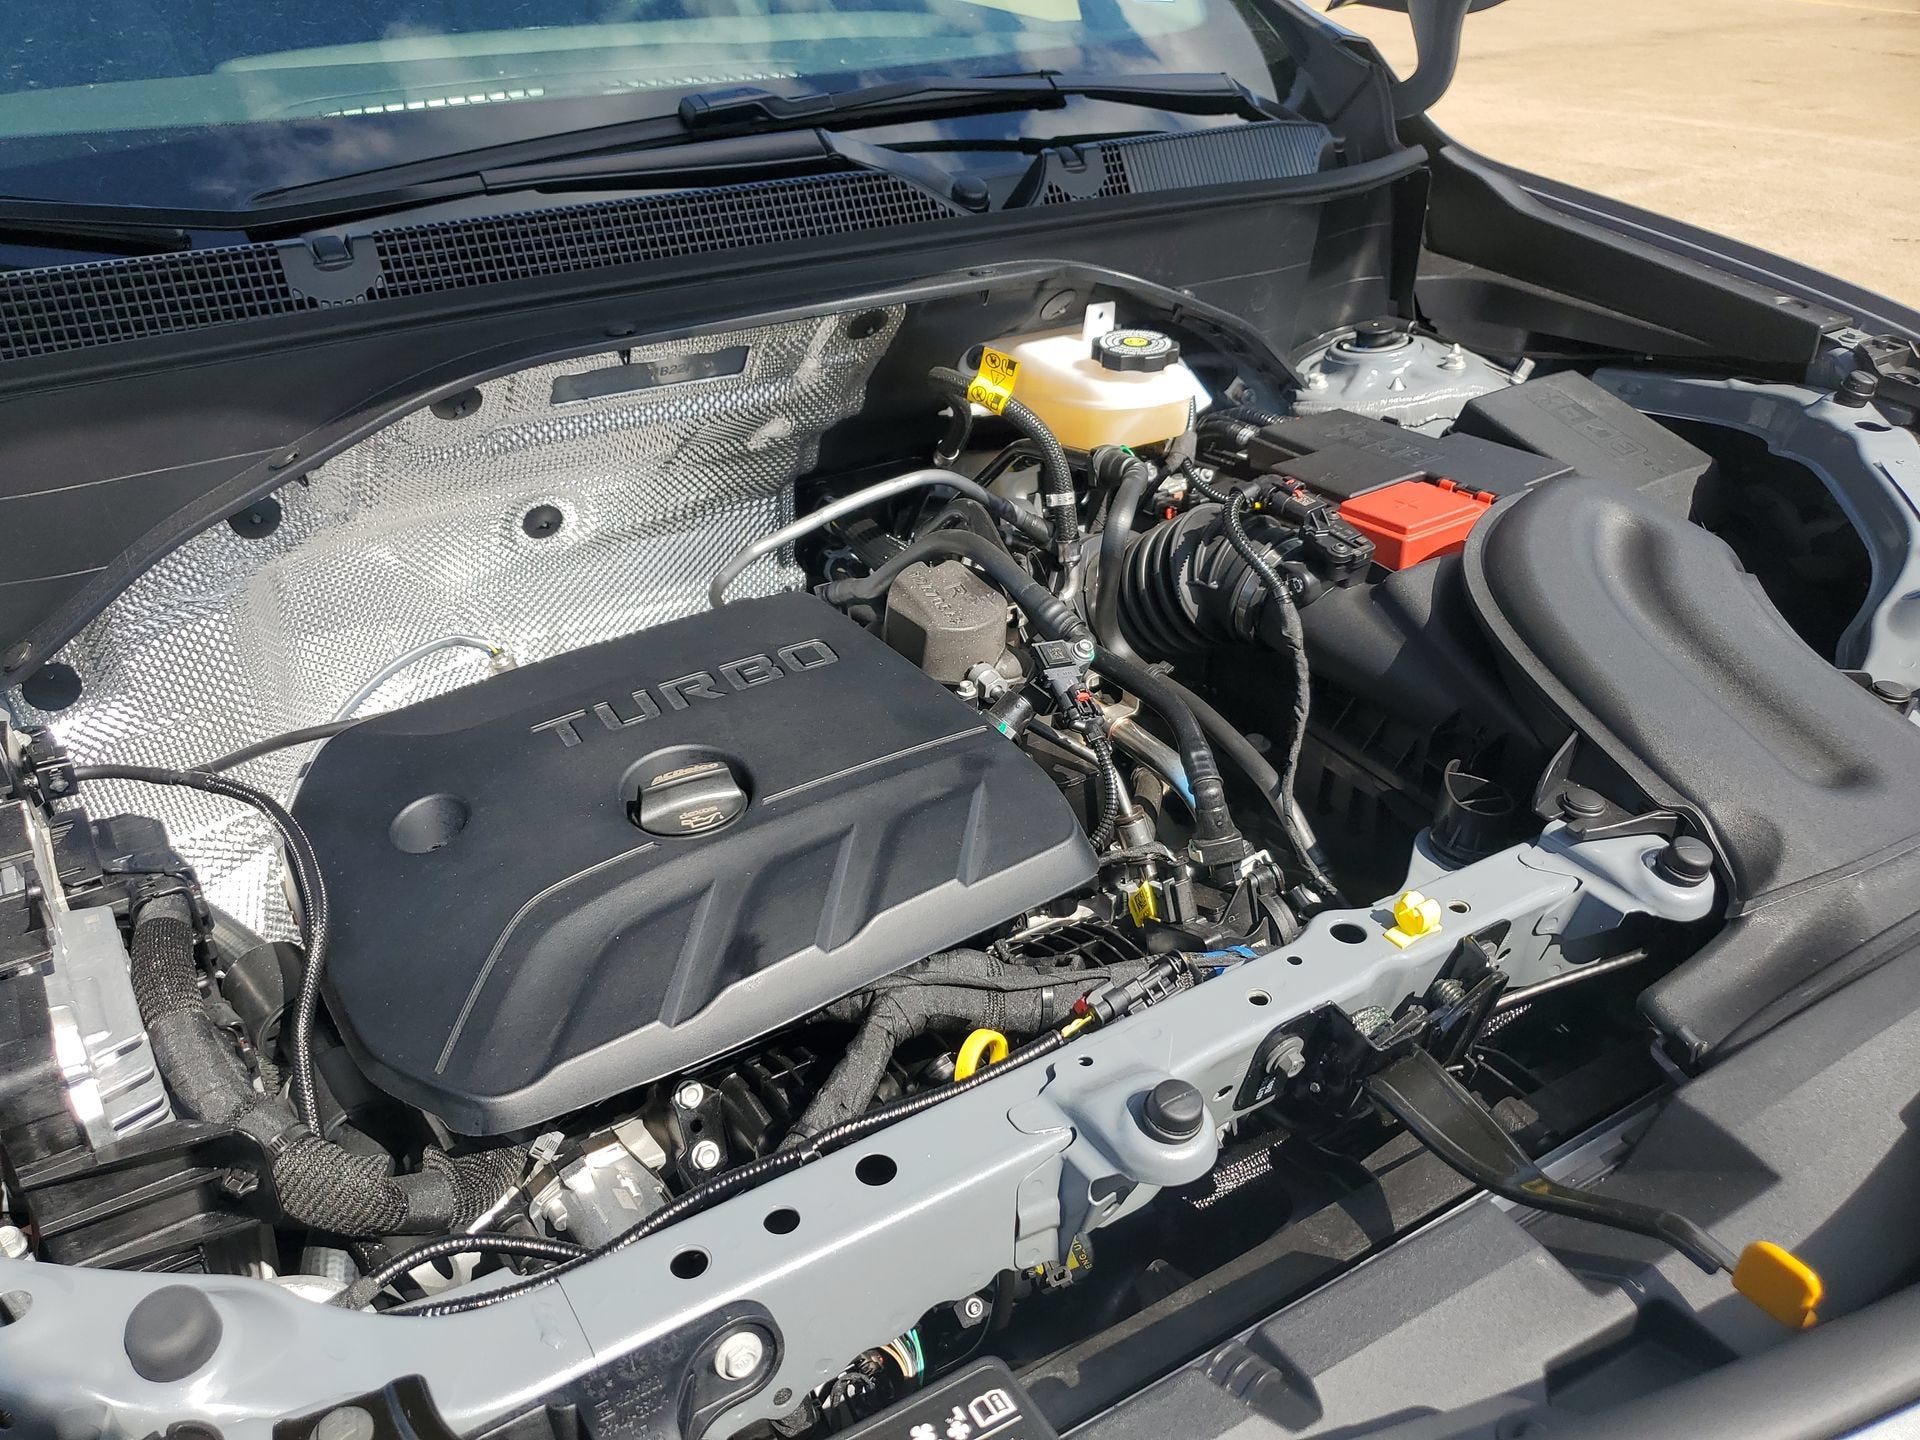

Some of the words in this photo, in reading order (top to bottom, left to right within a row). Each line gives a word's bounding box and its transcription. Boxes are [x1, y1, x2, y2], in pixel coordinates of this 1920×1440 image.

[529, 637, 840, 748] TURBO
[650, 761, 720, 787] ACDelco
[679, 805, 719, 820] dexos
